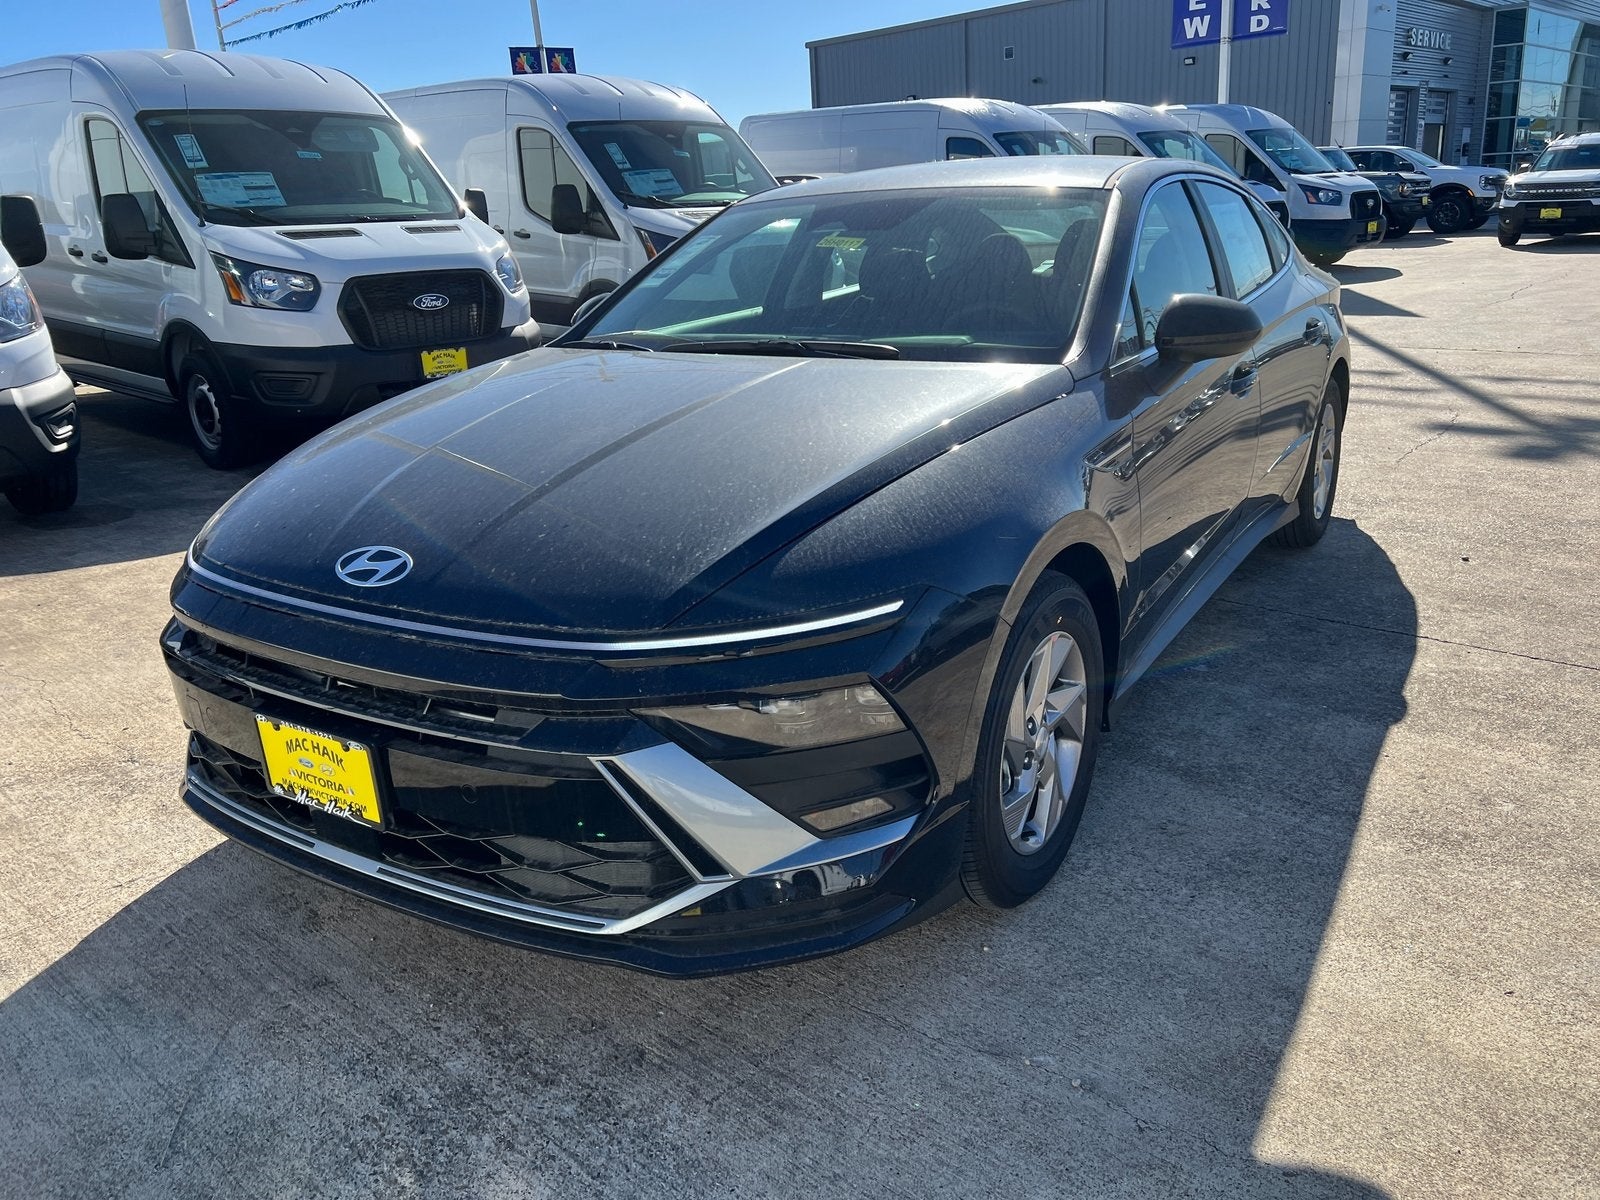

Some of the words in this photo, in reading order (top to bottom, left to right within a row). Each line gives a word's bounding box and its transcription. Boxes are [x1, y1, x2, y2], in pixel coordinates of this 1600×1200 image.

[1410, 27, 1452, 50] SERVICE
[420, 296, 443, 307] Ford
[432, 352, 443, 361] MAC
[443, 352, 456, 360] HAIK
[285, 737, 309, 755] MAC
[310, 740, 347, 772] HAIK
[295, 768, 345, 795] VICTORIA
[295, 789, 322, 809] Mac
[323, 800, 355, 818] Haik
